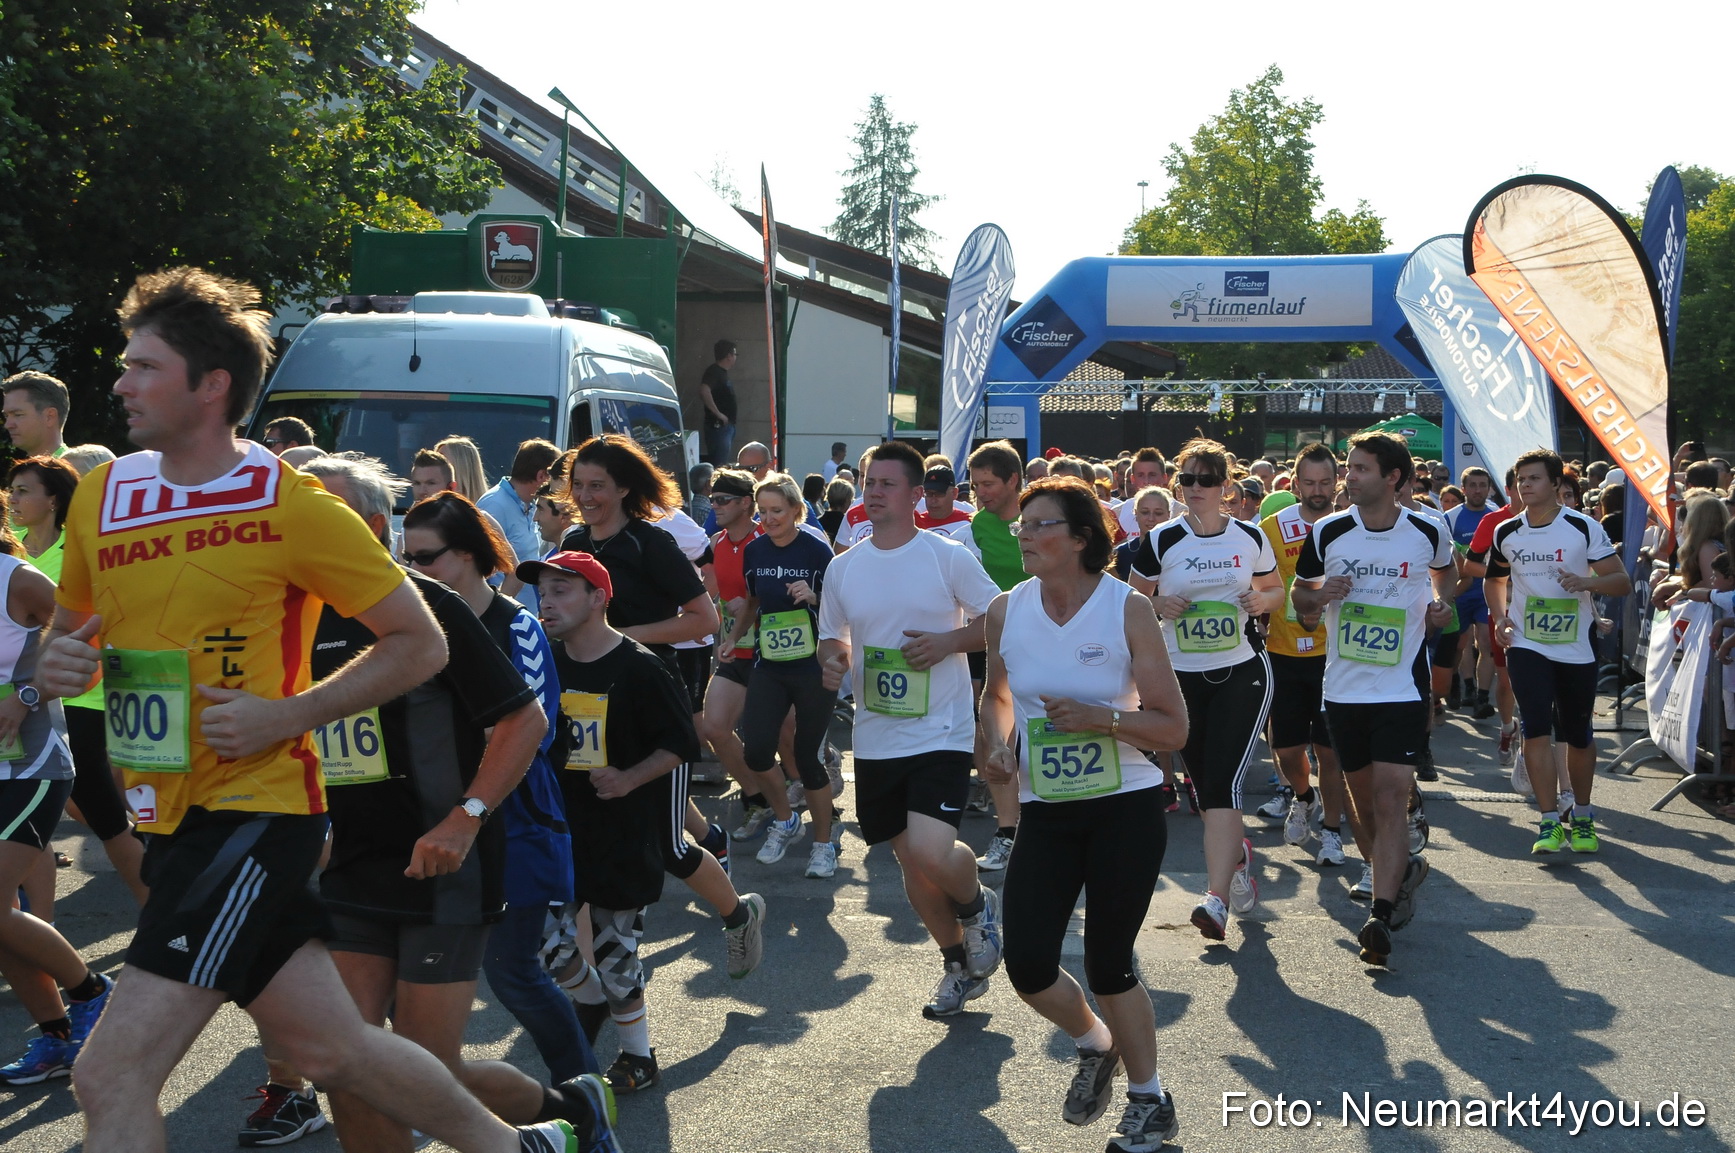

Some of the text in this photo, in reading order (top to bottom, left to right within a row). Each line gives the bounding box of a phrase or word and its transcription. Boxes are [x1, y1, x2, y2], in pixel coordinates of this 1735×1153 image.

[499, 274, 524, 285] 1628
[1208, 297, 1307, 315] firmenlauf
[963, 254, 1000, 387] Fischer
[1021, 330, 1074, 341] Fischer
[98, 519, 283, 572] MAX BÖGL
[1285, 545, 1302, 557] MA
[1185, 554, 1242, 572] Xplus1
[1511, 548, 1564, 565] Xplus1
[756, 567, 810, 578] EURO POLES
[1341, 559, 1409, 579] Xplus1
[1350, 587, 1384, 595] PORTGEIST
[1177, 617, 1236, 640] 1430
[1526, 612, 1576, 633] 1427
[766, 627, 805, 650] 352
[1340, 621, 1400, 652] 1429
[877, 671, 908, 700] 69
[108, 691, 168, 742] 800
[1041, 742, 1105, 780] 552
[1063, 784, 1085, 793] Dynamics
[1085, 782, 1100, 790] GmbH
